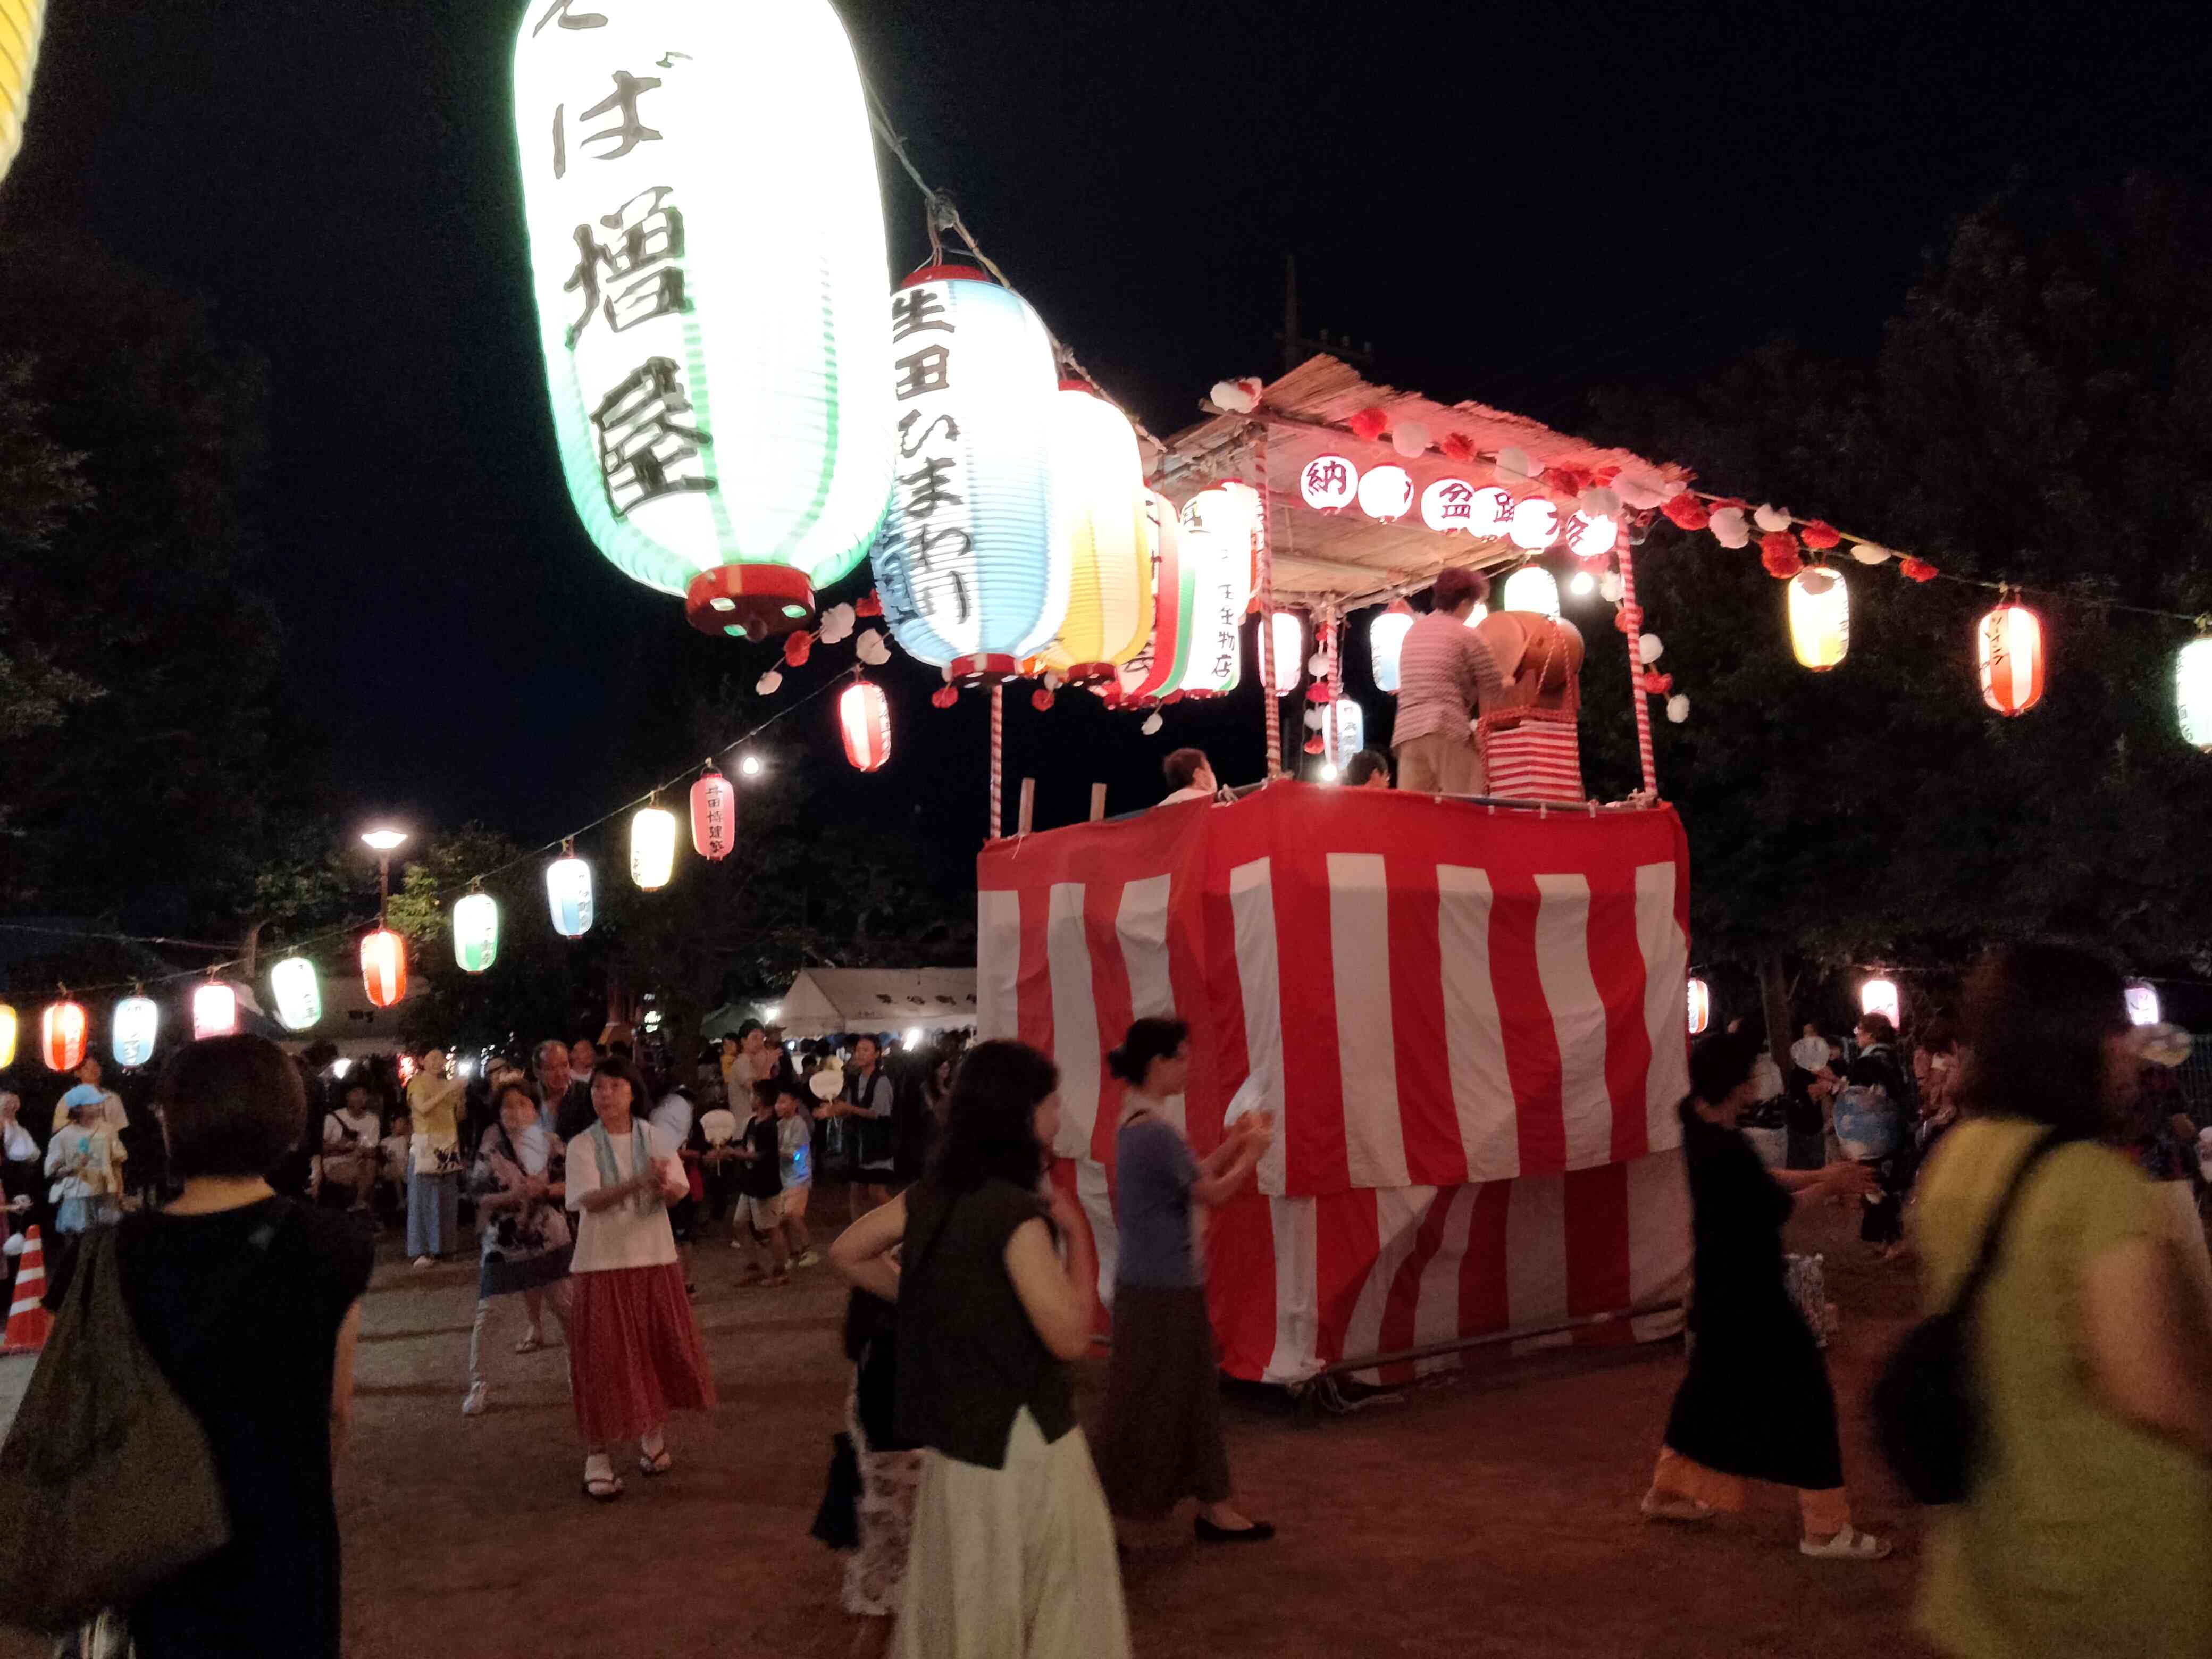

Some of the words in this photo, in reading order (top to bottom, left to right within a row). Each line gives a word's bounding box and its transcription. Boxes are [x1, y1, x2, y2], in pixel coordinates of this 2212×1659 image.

[891, 288, 973, 625] 生田ひまわり
